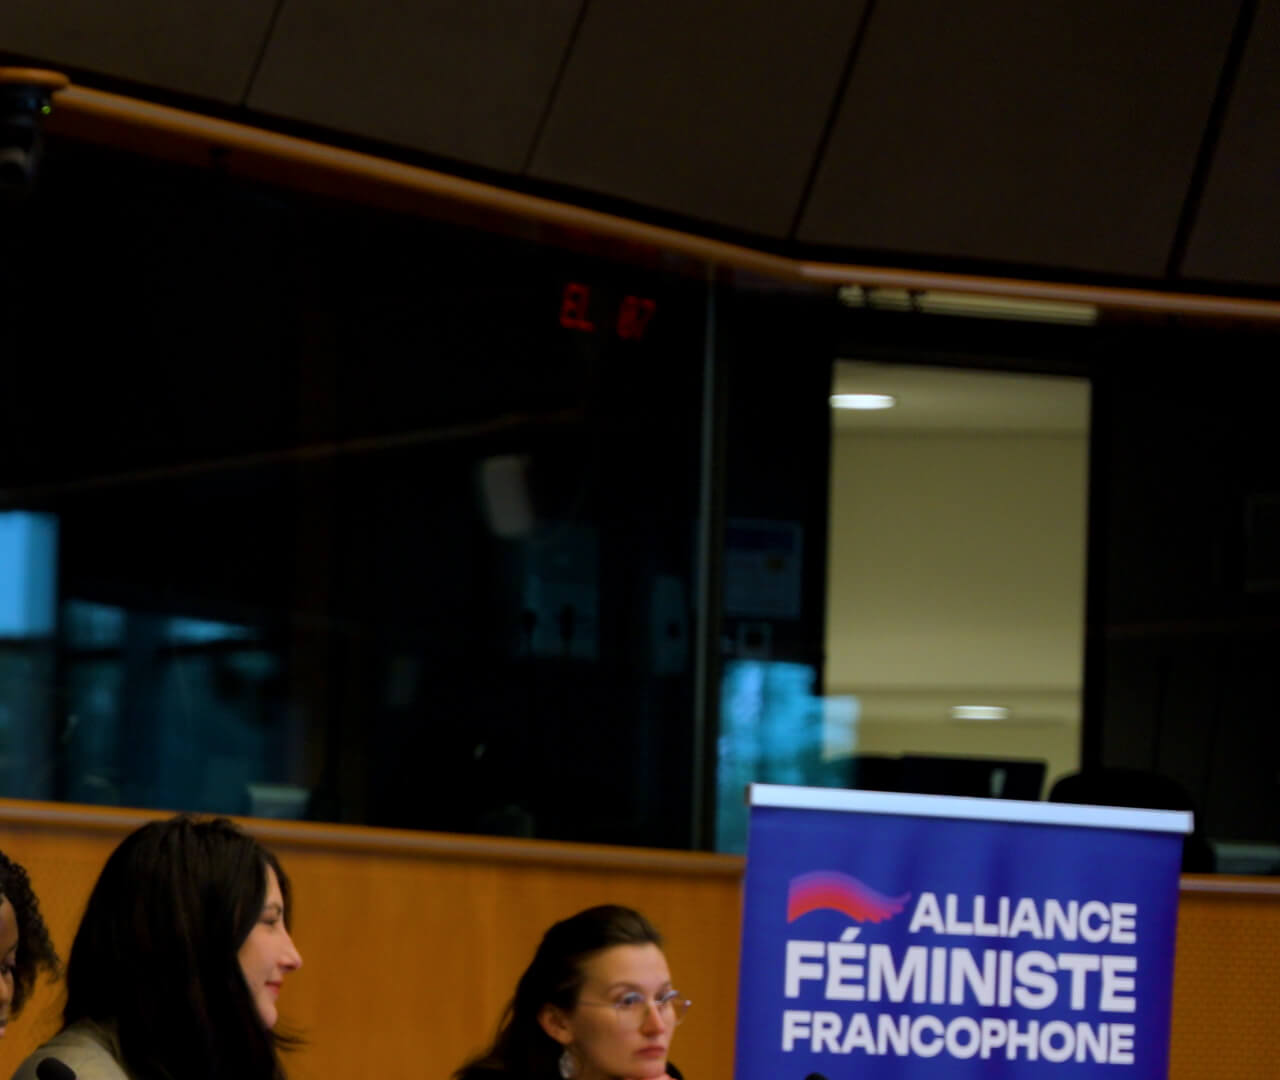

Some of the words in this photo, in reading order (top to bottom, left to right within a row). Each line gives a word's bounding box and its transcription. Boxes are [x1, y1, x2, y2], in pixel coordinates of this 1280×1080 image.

[560, 281, 597, 334] EL
[909, 891, 1138, 945] ALLIANCE
[784, 926, 1138, 1013] FÉMINISTE
[781, 1008, 1136, 1065] FRANCOPHONE
